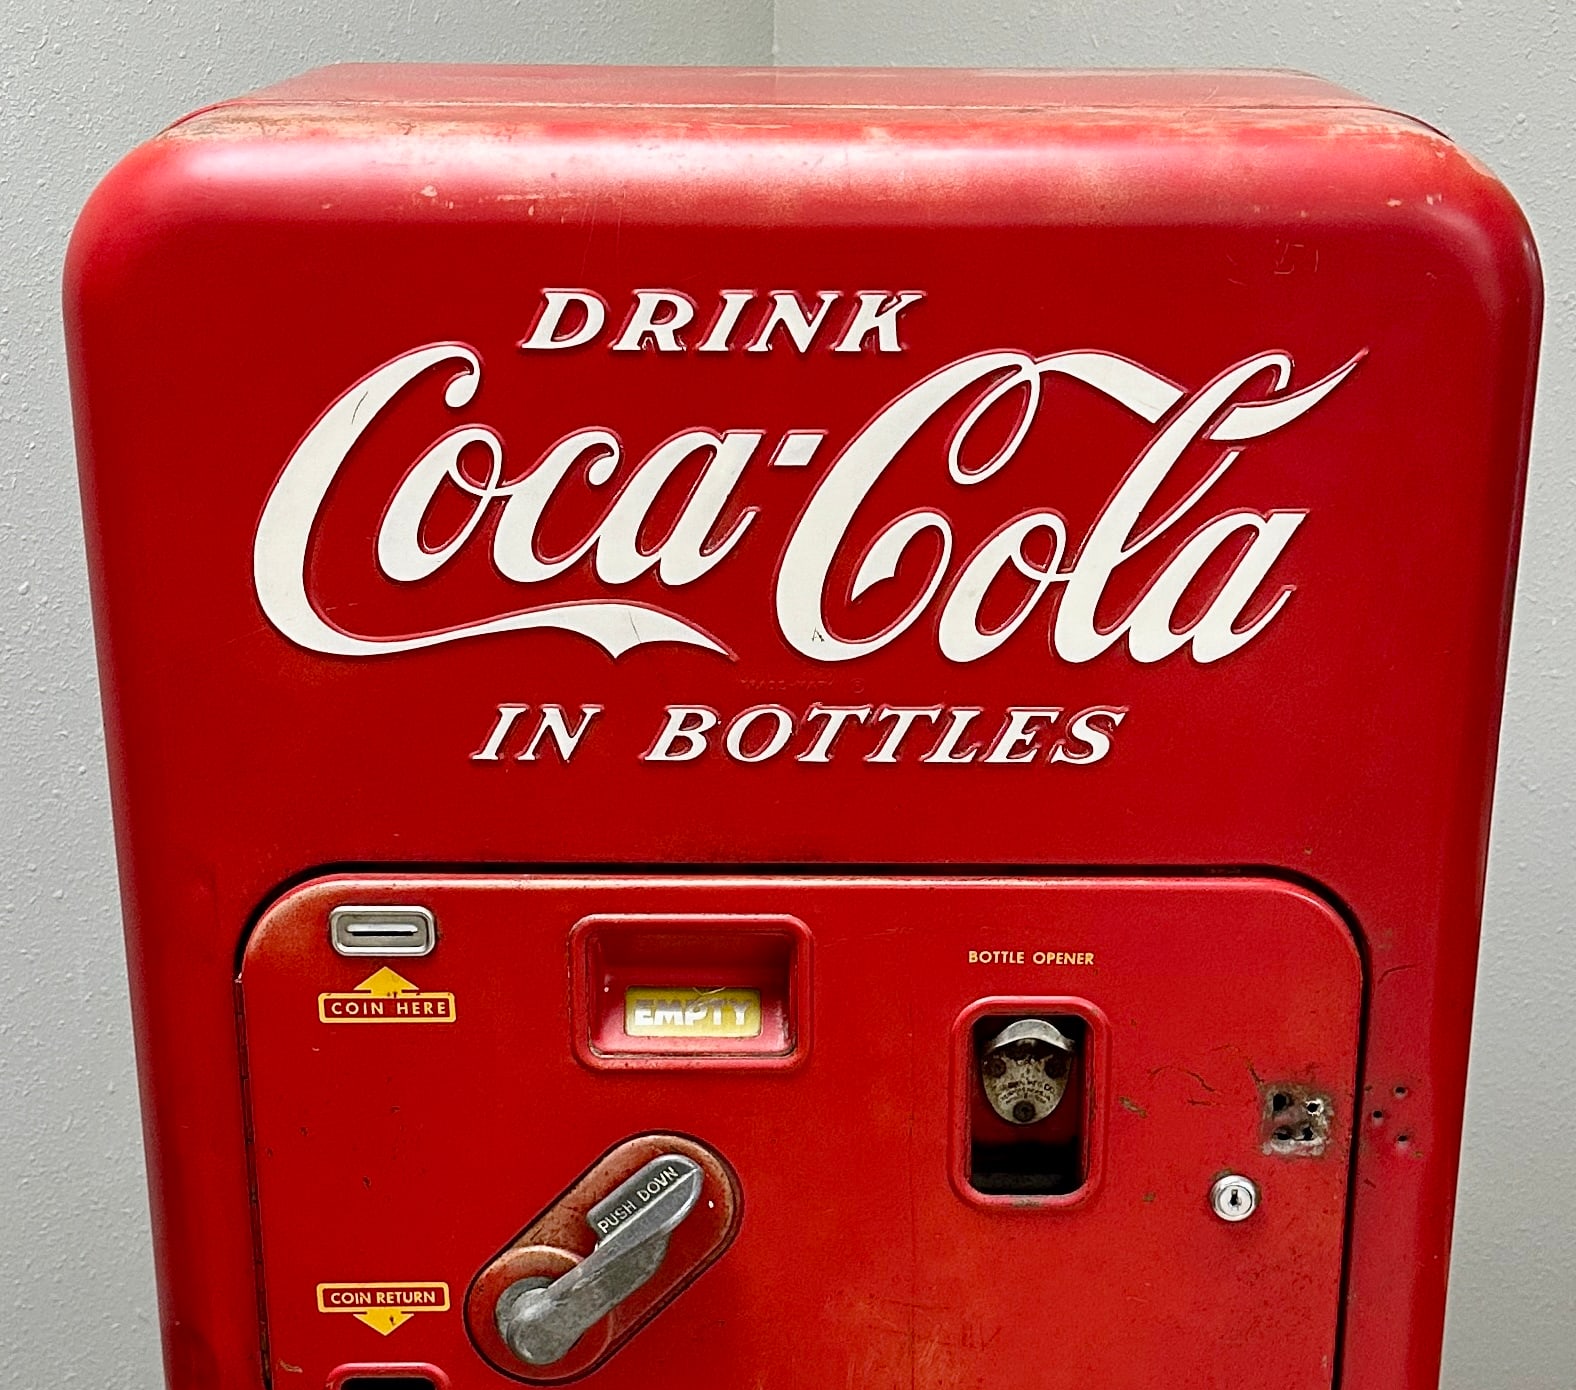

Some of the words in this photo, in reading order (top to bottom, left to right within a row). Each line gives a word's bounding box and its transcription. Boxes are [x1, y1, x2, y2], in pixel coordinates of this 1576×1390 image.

[521, 287, 923, 353] DRINK
[252, 344, 1368, 664] Coca-Cola
[471, 705, 605, 764] IN
[644, 703, 1127, 766] BOTTLES
[968, 950, 1025, 964] BOTTLE
[1032, 951, 1095, 966] OPENER
[331, 1001, 384, 1015] COIN
[396, 1001, 446, 1015] HERE
[634, 997, 751, 1026] EMPTY
[597, 1199, 637, 1234] PUSH
[330, 1291, 372, 1305] COIN
[376, 1290, 436, 1304] RETURN
